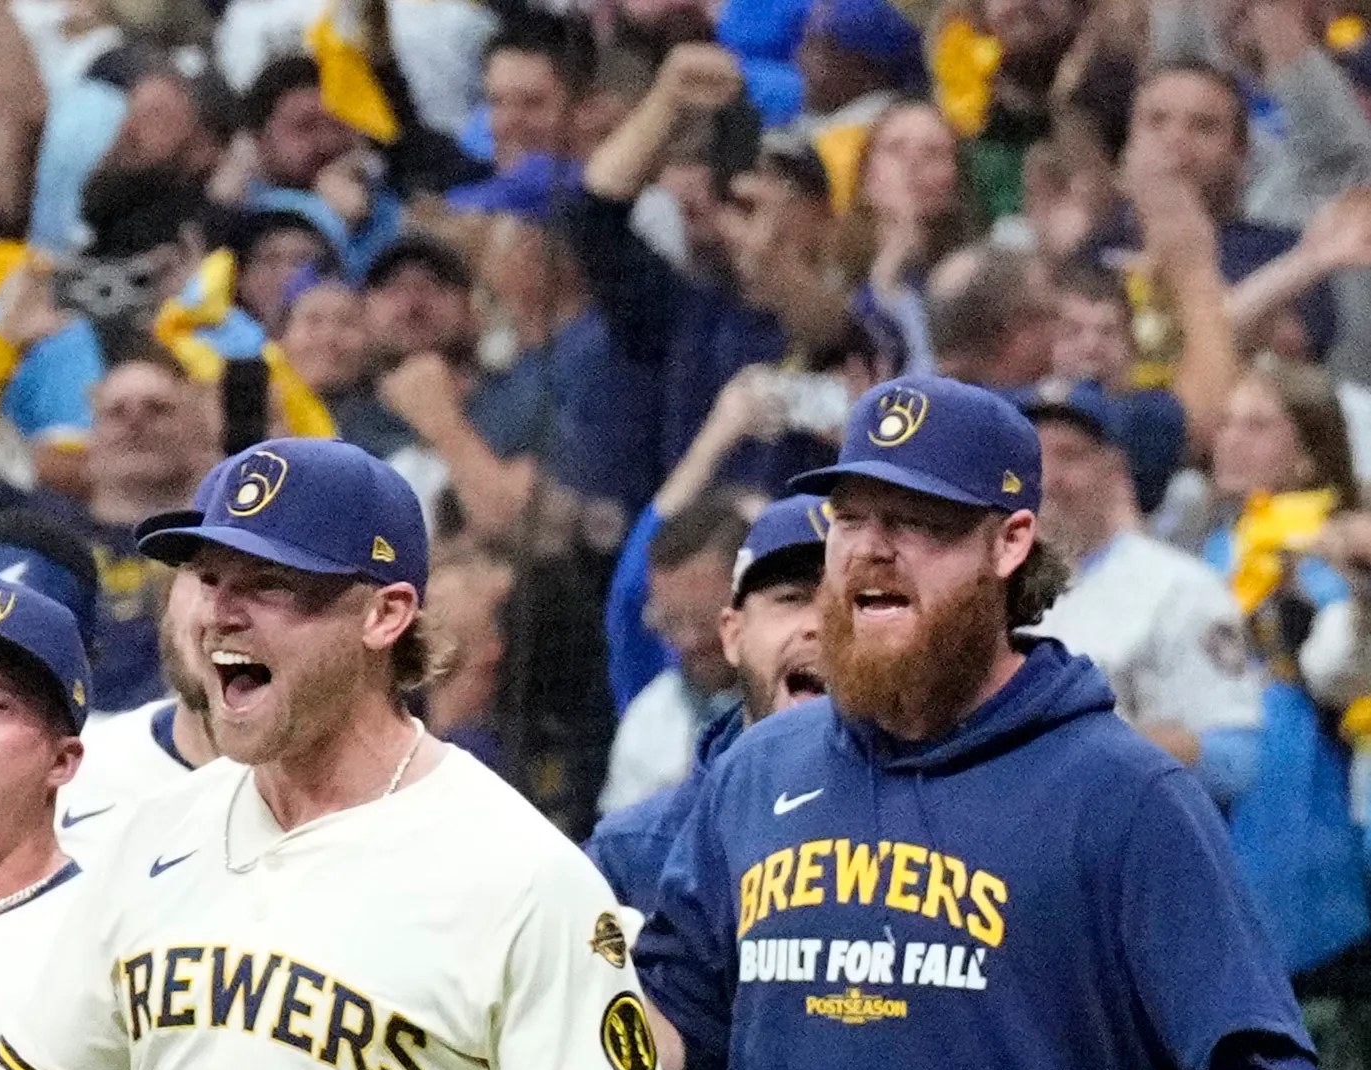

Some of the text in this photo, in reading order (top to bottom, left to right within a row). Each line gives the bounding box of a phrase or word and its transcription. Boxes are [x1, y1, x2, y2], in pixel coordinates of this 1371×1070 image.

[737, 837, 1008, 948] BREWERS
[738, 938, 988, 991] BUILT FOR FALL
[806, 996, 908, 1018] POSTSEASON
